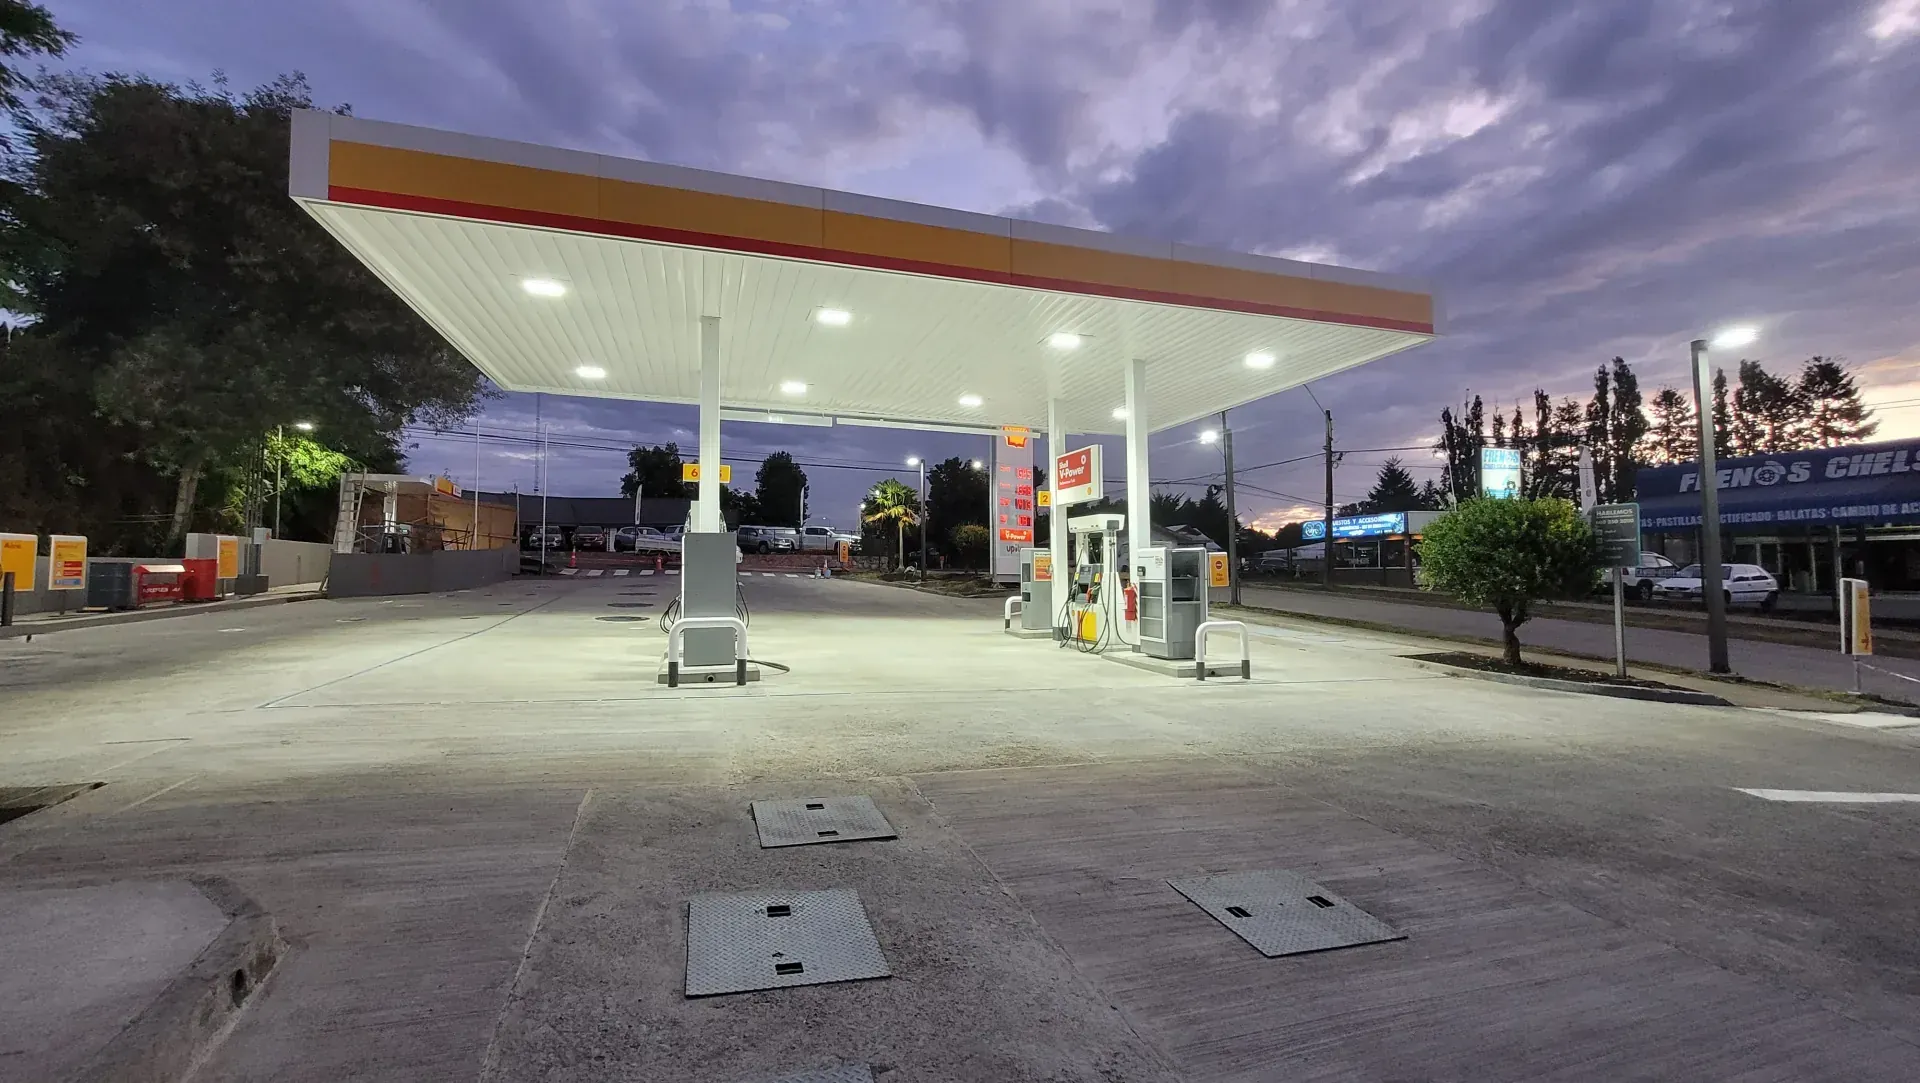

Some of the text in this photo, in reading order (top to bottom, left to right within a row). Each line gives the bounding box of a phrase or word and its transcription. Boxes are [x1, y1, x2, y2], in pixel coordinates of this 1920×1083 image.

[691, 468, 698, 477] 6
[1042, 494, 1049, 503] 2
[1596, 508, 1634, 517] HABLEMOS
[1332, 518, 1351, 526] UESTOS
[1719, 511, 1771, 524] CTIFICADO
